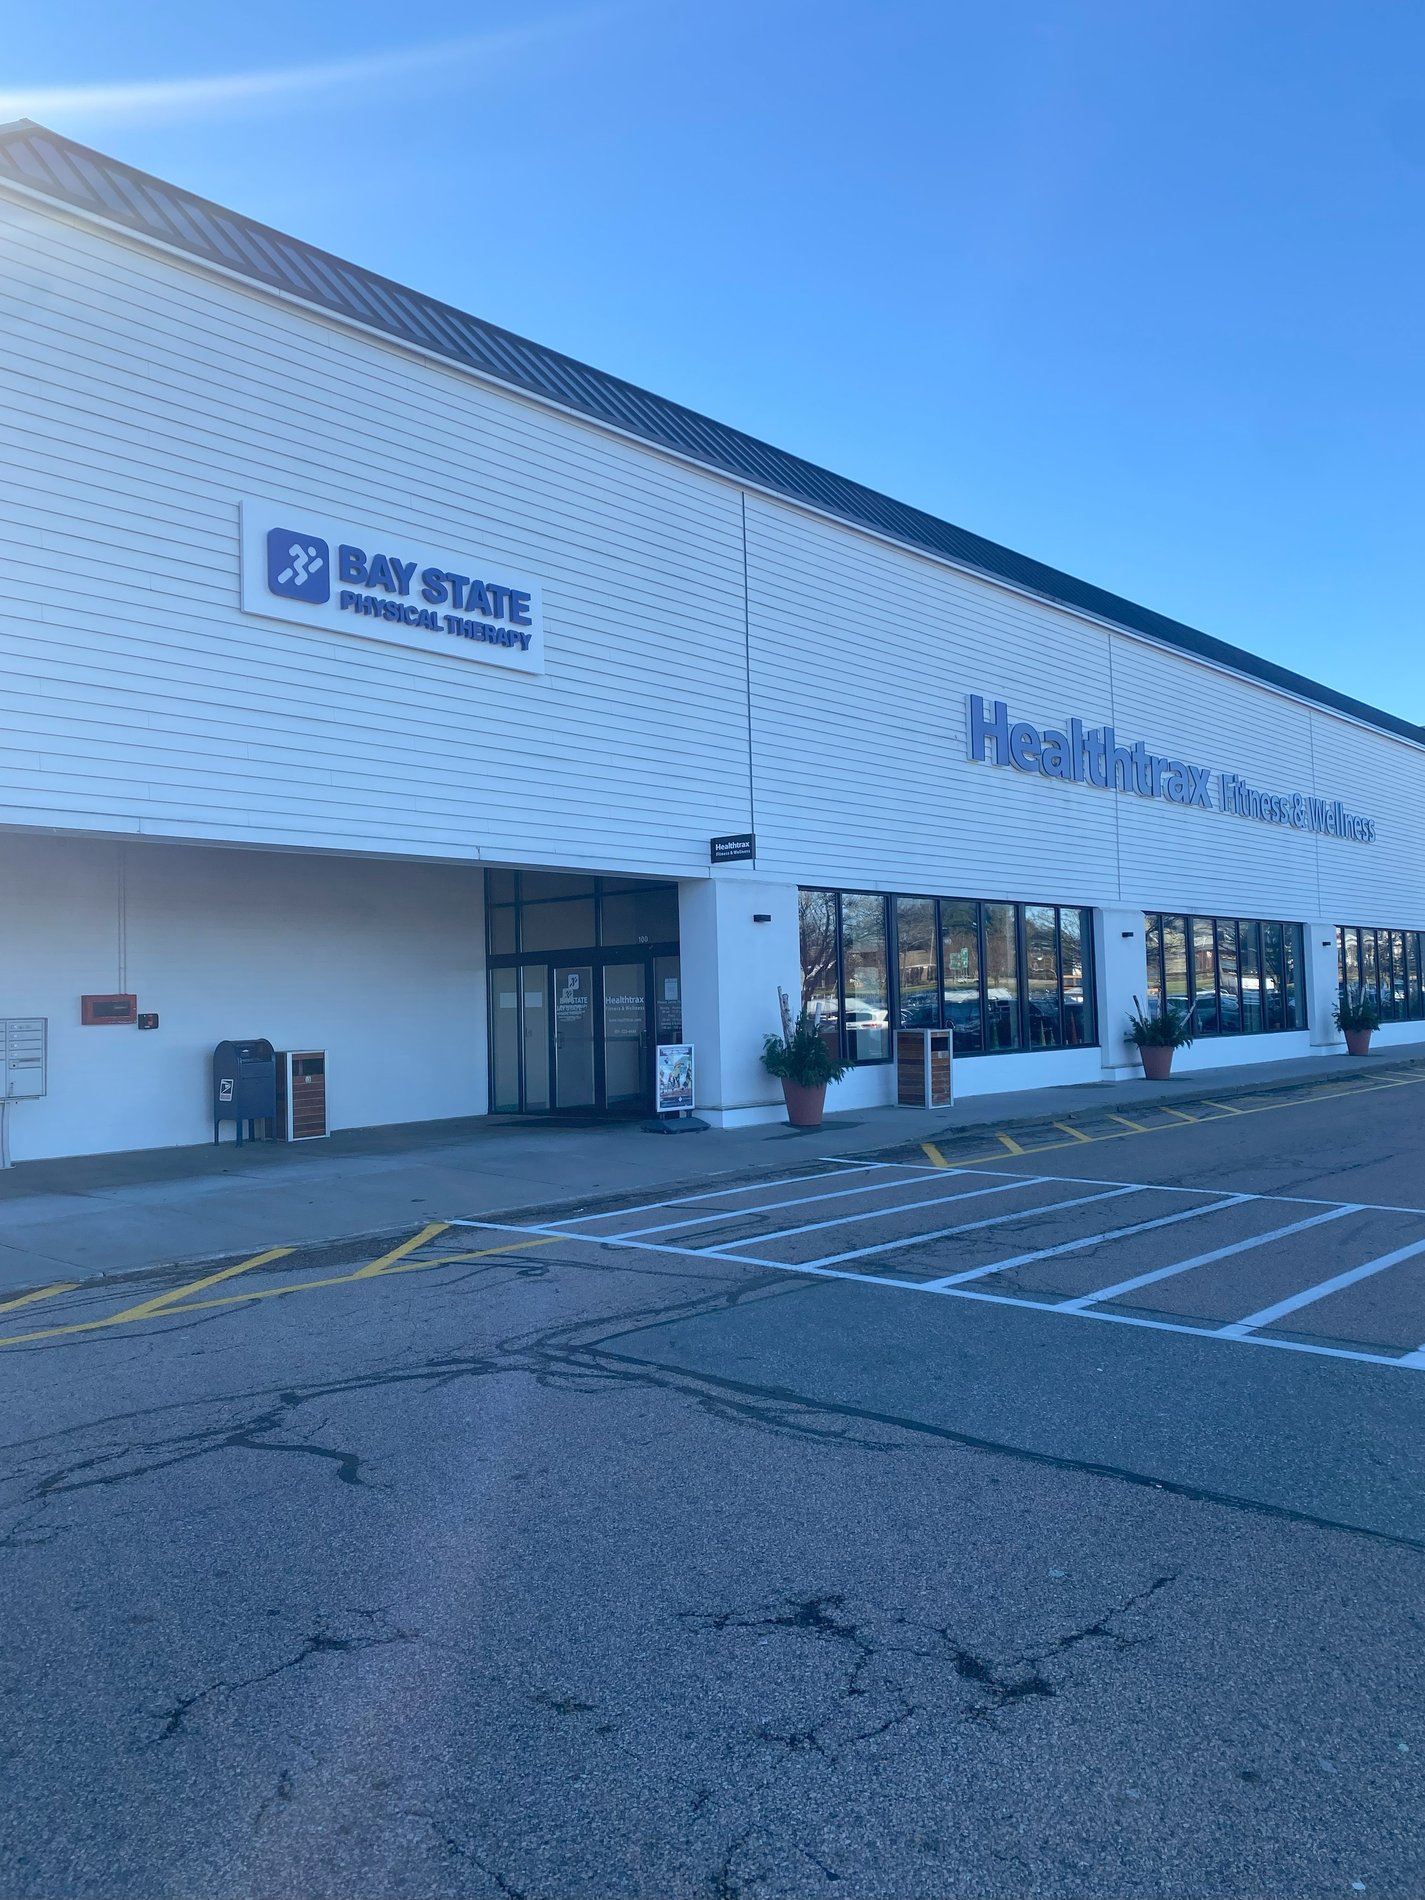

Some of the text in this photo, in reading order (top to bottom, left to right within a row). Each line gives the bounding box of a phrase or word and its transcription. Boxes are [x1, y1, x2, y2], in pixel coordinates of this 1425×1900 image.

[338, 544, 532, 626] BAY STATE
[340, 590, 532, 651] PHYSICAL THERAPY
[967, 694, 1377, 844] Healthtrax Fitness & Wellness
[715, 841, 750, 851] Healthtrax
[638, 935, 649, 943] 100
[605, 995, 644, 1004] Healthtrax
